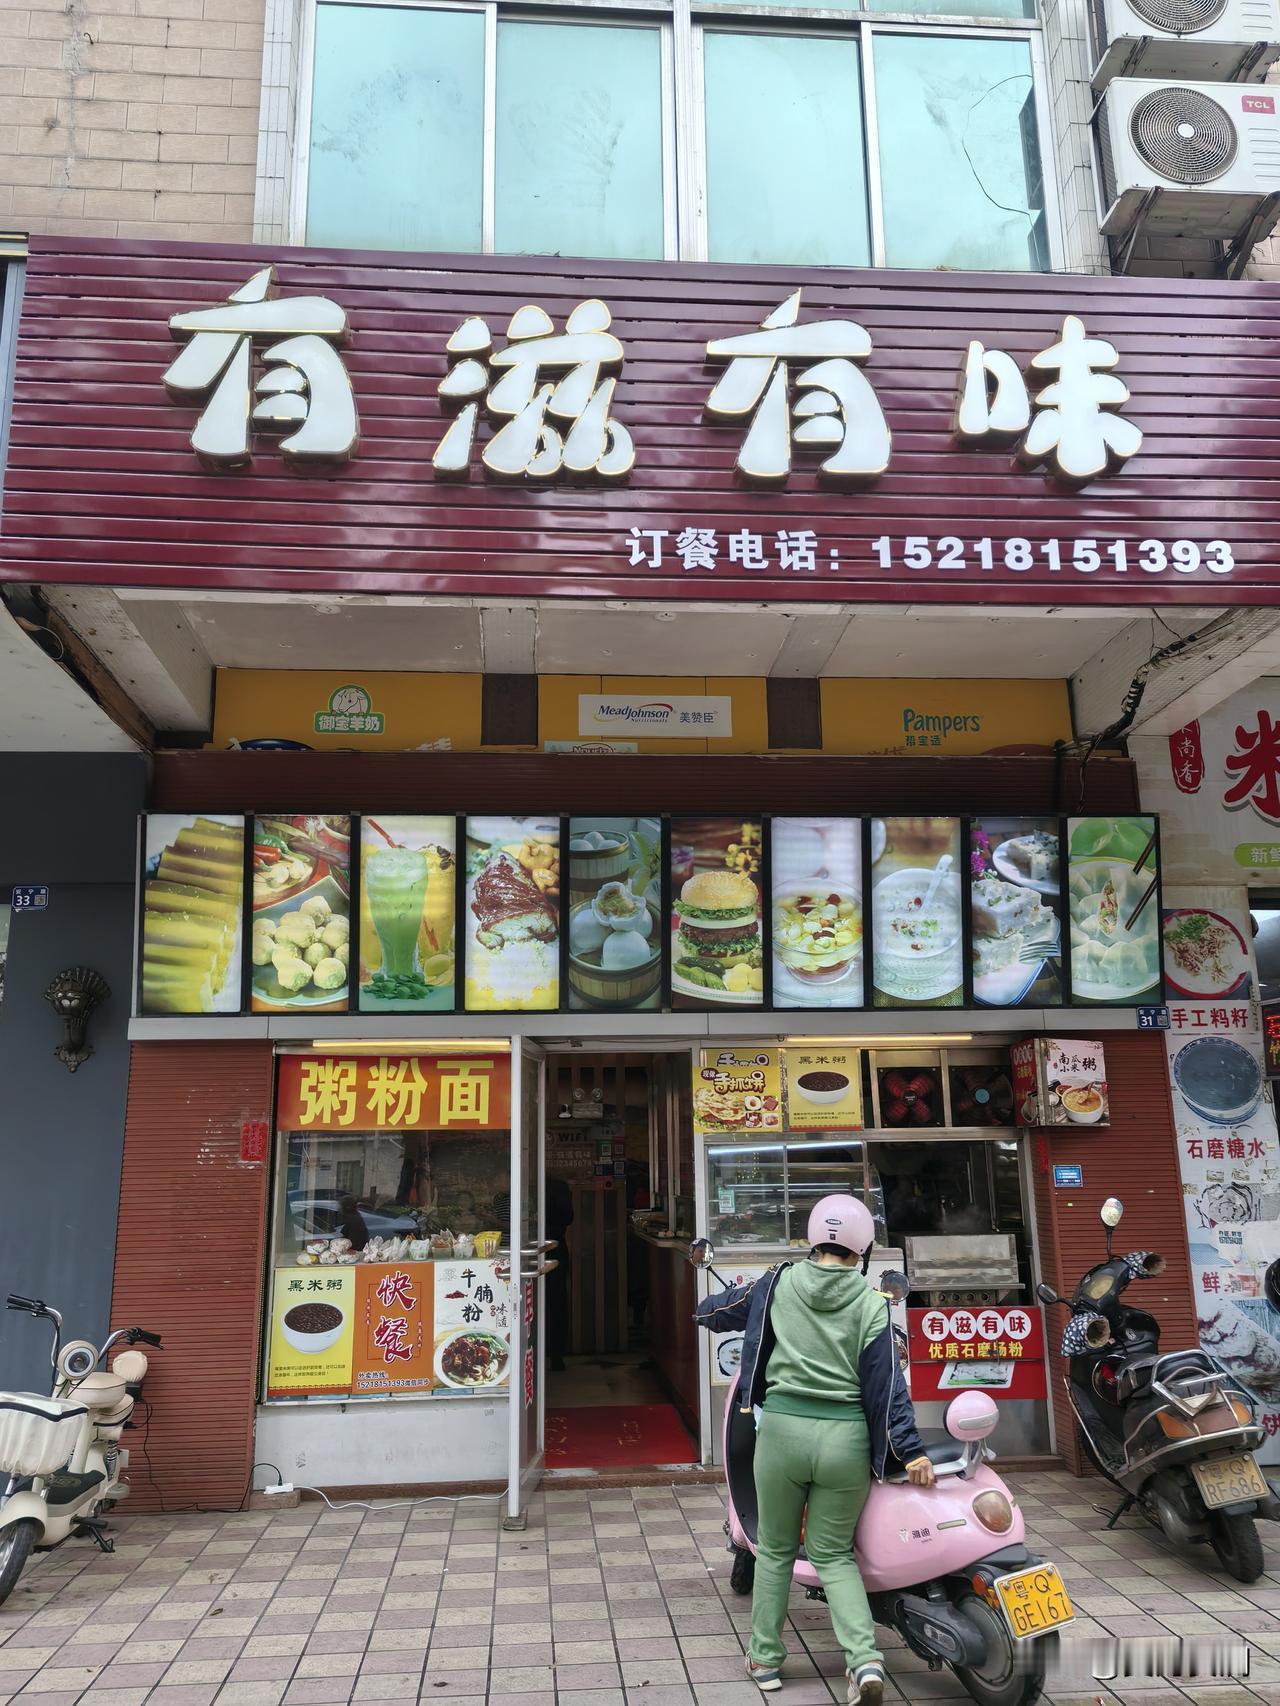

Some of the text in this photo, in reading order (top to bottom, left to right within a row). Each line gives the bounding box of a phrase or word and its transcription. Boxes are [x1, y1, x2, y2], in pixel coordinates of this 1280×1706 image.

[1246, 100, 1270, 109] TCL
[161, 264, 1144, 480] 有滋有味
[871, 535, 1236, 574] 15218151393
[318, 715, 380, 732] 御宝羊奶
[679, 711, 715, 724] 美赞臣
[902, 708, 981, 738] Pampers
[15, 895, 30, 906] 33
[1141, 1016, 1153, 1026] 31
[798, 1055, 847, 1065] 黑米粥
[299, 1057, 494, 1126] 粥粉面
[713, 1070, 766, 1094] 手抓饼
[1185, 1137, 1266, 1160] 石磨糖水
[287, 1278, 344, 1293] 黑米粥
[374, 1271, 416, 1365] 快餐
[927, 1315, 1027, 1335] 有滋有味
[1205, 1475, 1262, 1502] RF686
[1013, 1592, 1069, 1631] GE167
